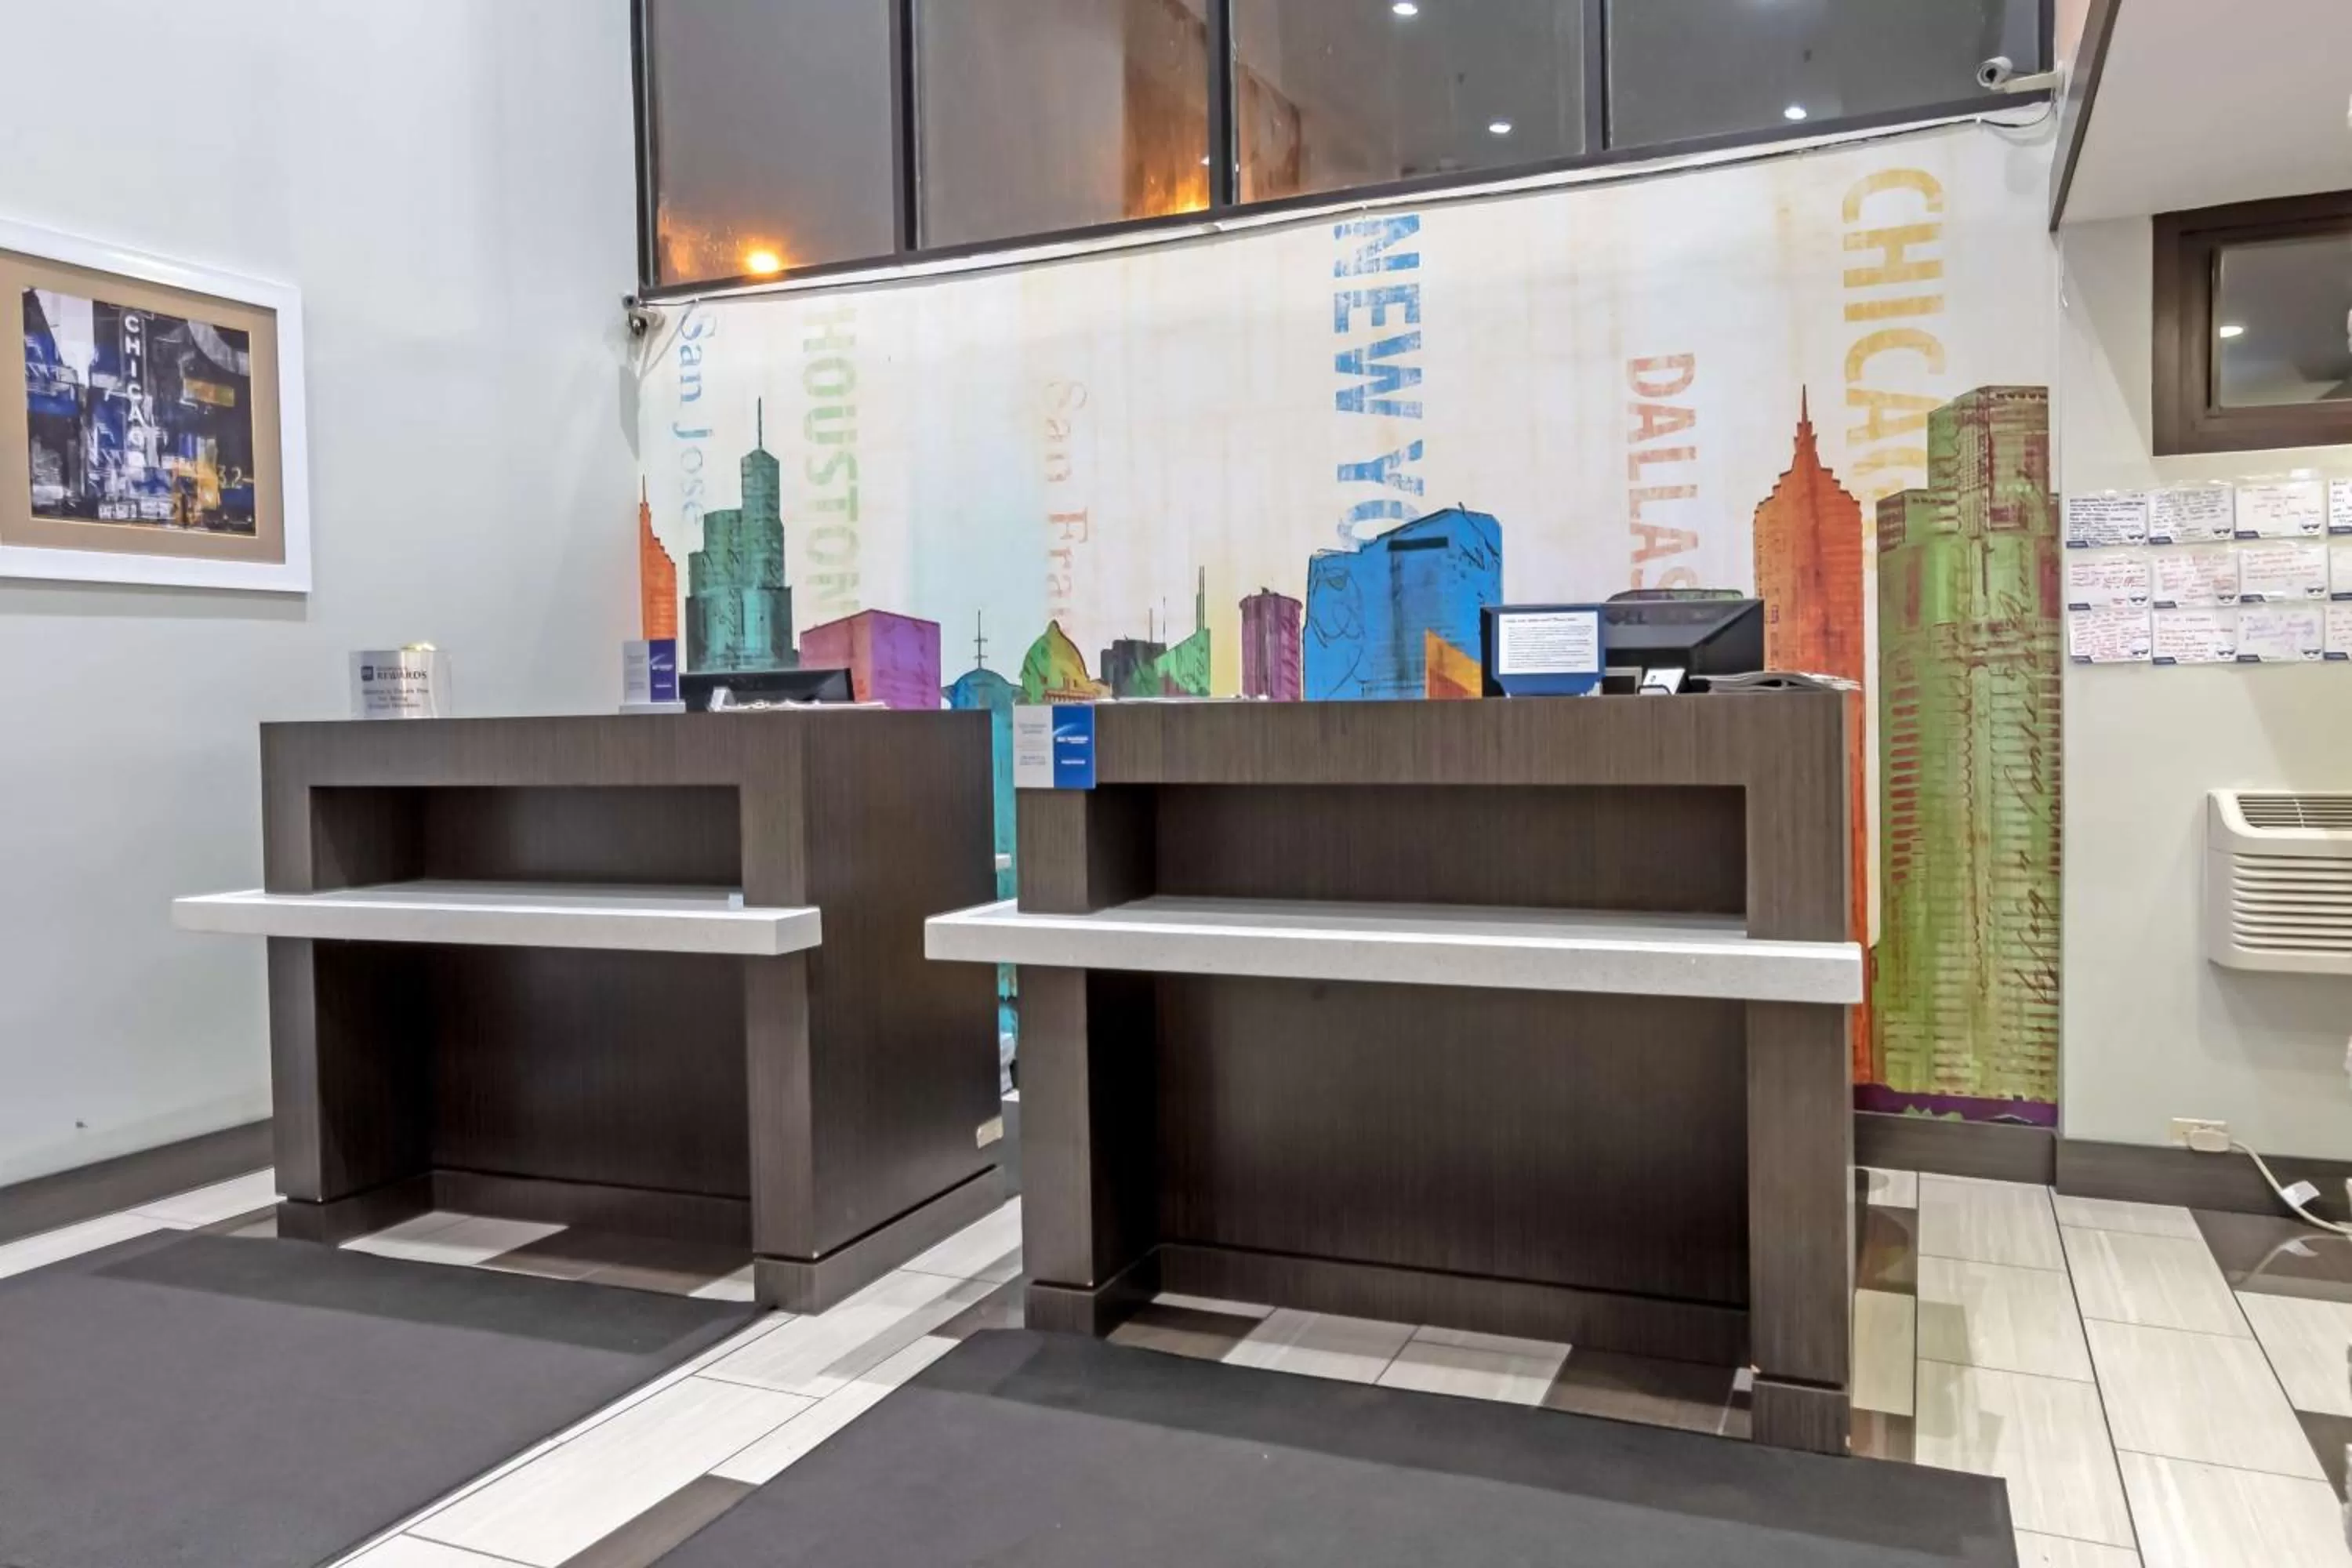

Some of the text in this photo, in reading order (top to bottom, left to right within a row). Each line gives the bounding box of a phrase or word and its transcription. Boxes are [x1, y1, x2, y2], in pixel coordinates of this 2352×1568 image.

[672, 314, 717, 524] San Jose
[1334, 212, 1422, 419] NEW
[1841, 167, 1946, 570] CHICAG
[802, 306, 862, 613] HOUSTON
[1045, 381, 1090, 482] San
